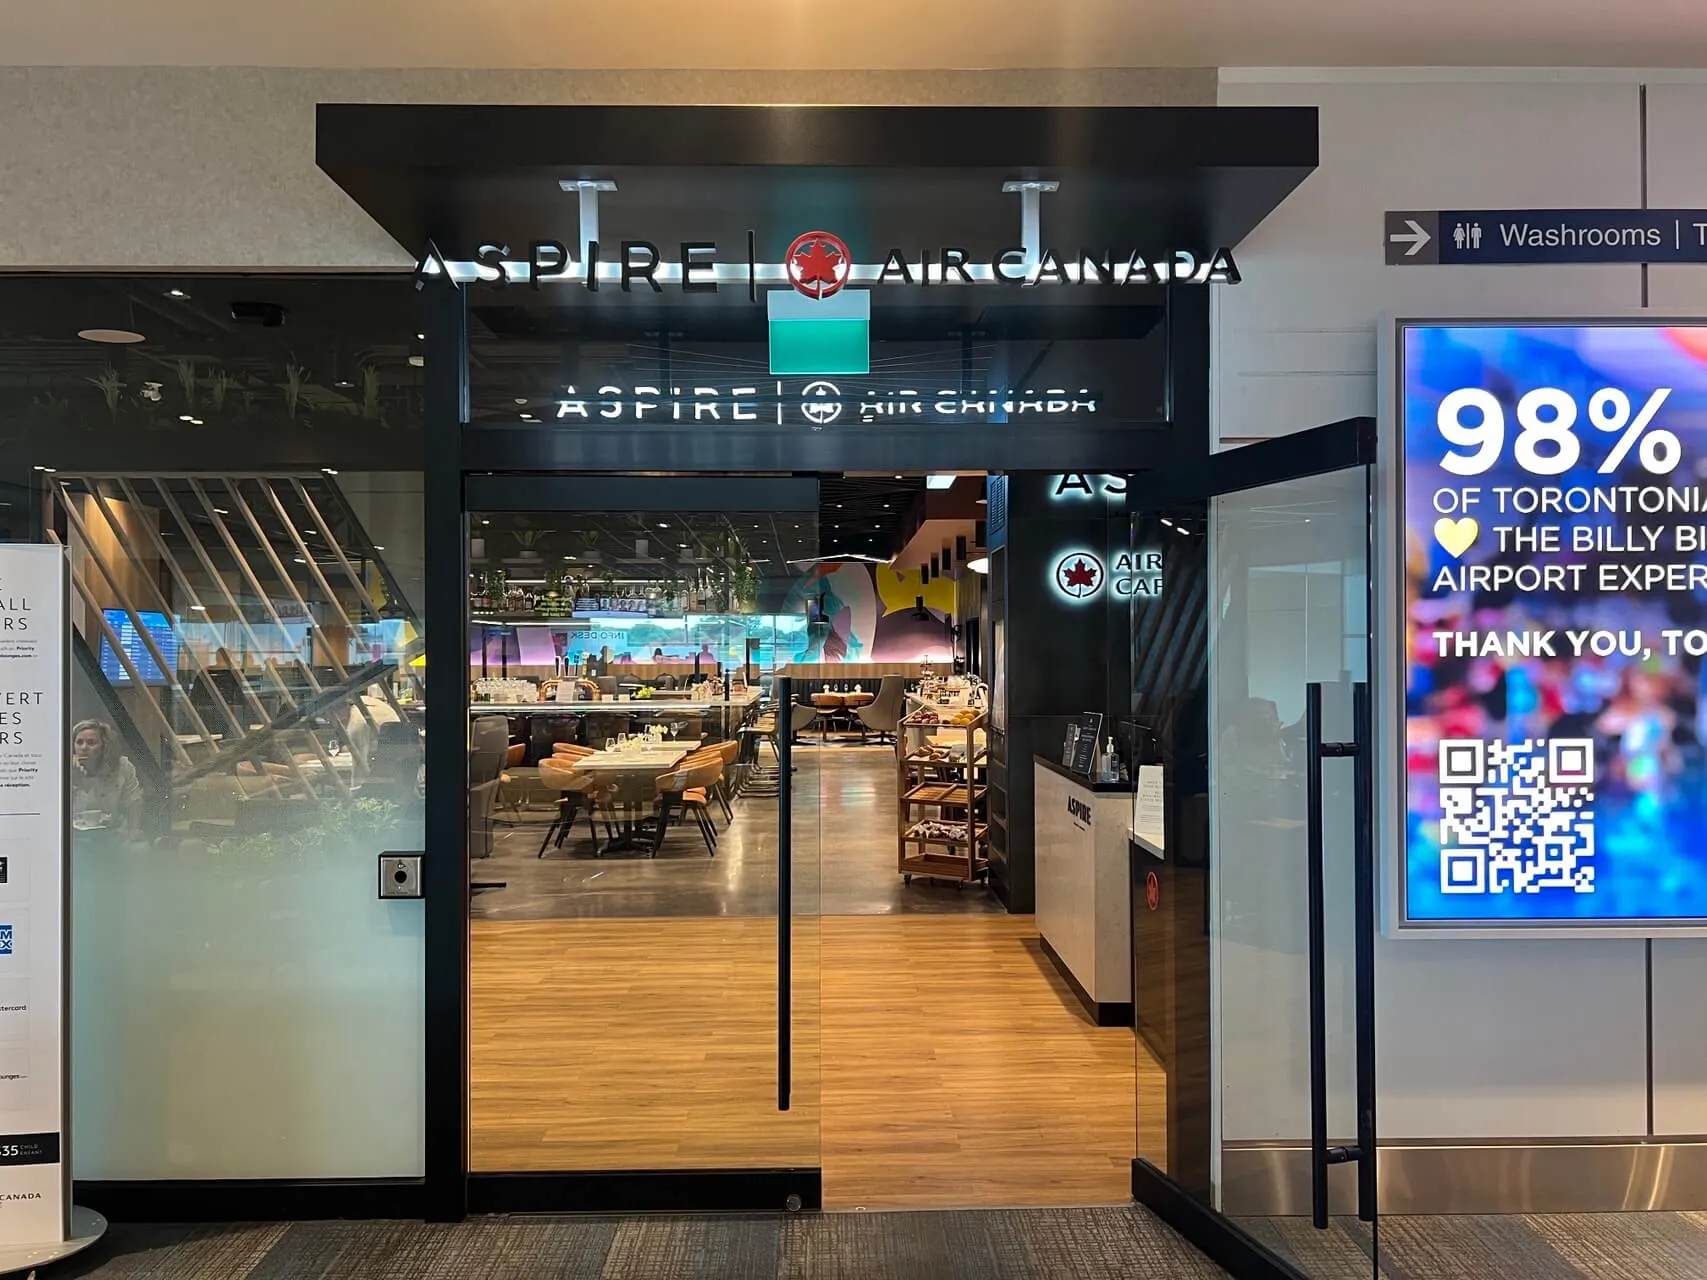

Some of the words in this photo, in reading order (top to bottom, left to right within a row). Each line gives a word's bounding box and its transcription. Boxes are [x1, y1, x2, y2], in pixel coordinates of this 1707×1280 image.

[1499, 222, 1662, 247] Washrooms
[412, 238, 720, 293] ASPIRE
[877, 247, 976, 286] AIR
[991, 246, 1243, 288] CANADA
[556, 385, 758, 420] ASPIRE
[1436, 386, 1682, 477] 98%
[1432, 487, 1481, 514] OF
[1492, 486, 1707, 514] TORONTONI
[1492, 525, 1561, 553] THE
[1572, 525, 1665, 553] BILLY
[1675, 525, 1707, 552] BI
[1115, 554, 1163, 570] AIR
[1432, 565, 1587, 592] AIRPORT
[1599, 564, 1707, 592] EXPER
[1432, 630, 1557, 658] THANK
[1564, 629, 1651, 661] YOU,
[1661, 629, 1707, 657] TO
[0, 692, 43, 705] ERT
[0, 1144, 19, 1156] 35
